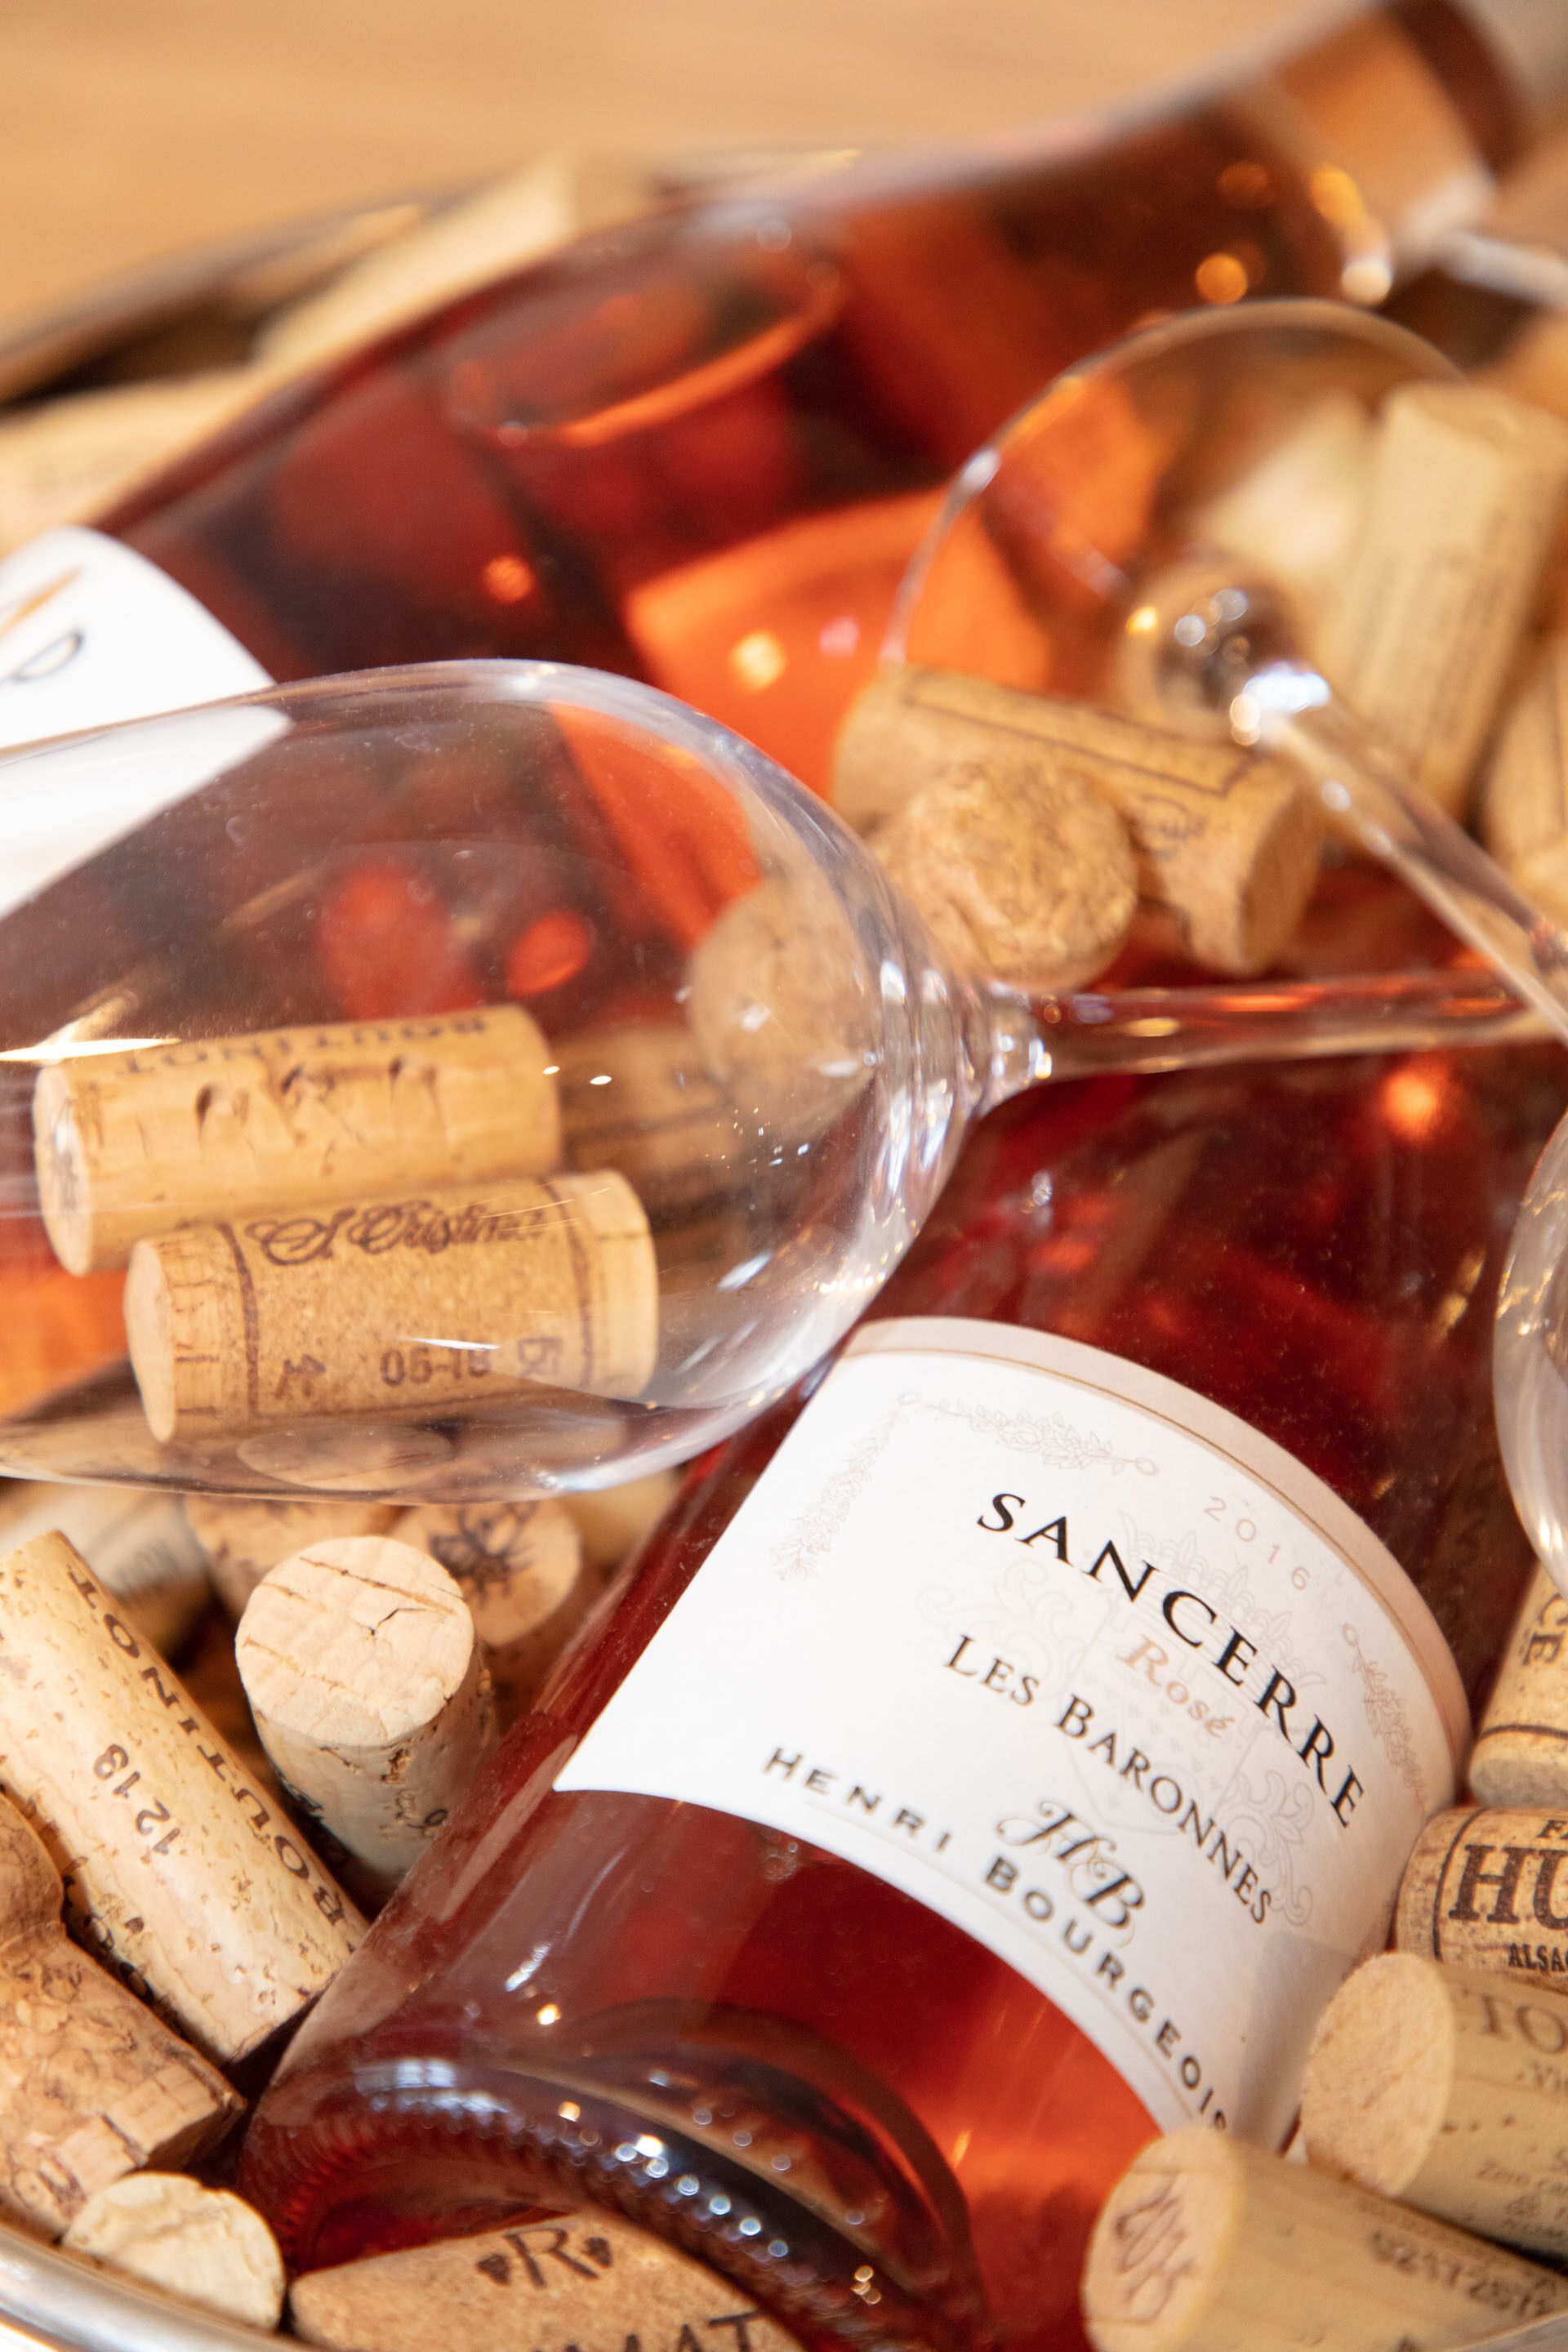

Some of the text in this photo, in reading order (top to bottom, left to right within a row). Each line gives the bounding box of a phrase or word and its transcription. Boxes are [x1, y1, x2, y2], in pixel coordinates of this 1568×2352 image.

[1202, 1495, 1311, 1592] 2016
[66, 1563, 346, 1927] BOUTINOT
[976, 1492, 1365, 1829] SANCERRE
[1115, 1633, 1235, 1739] Rosé
[762, 1746, 952, 1854] HENRI
[943, 1634, 1272, 1926] LES BARONNES
